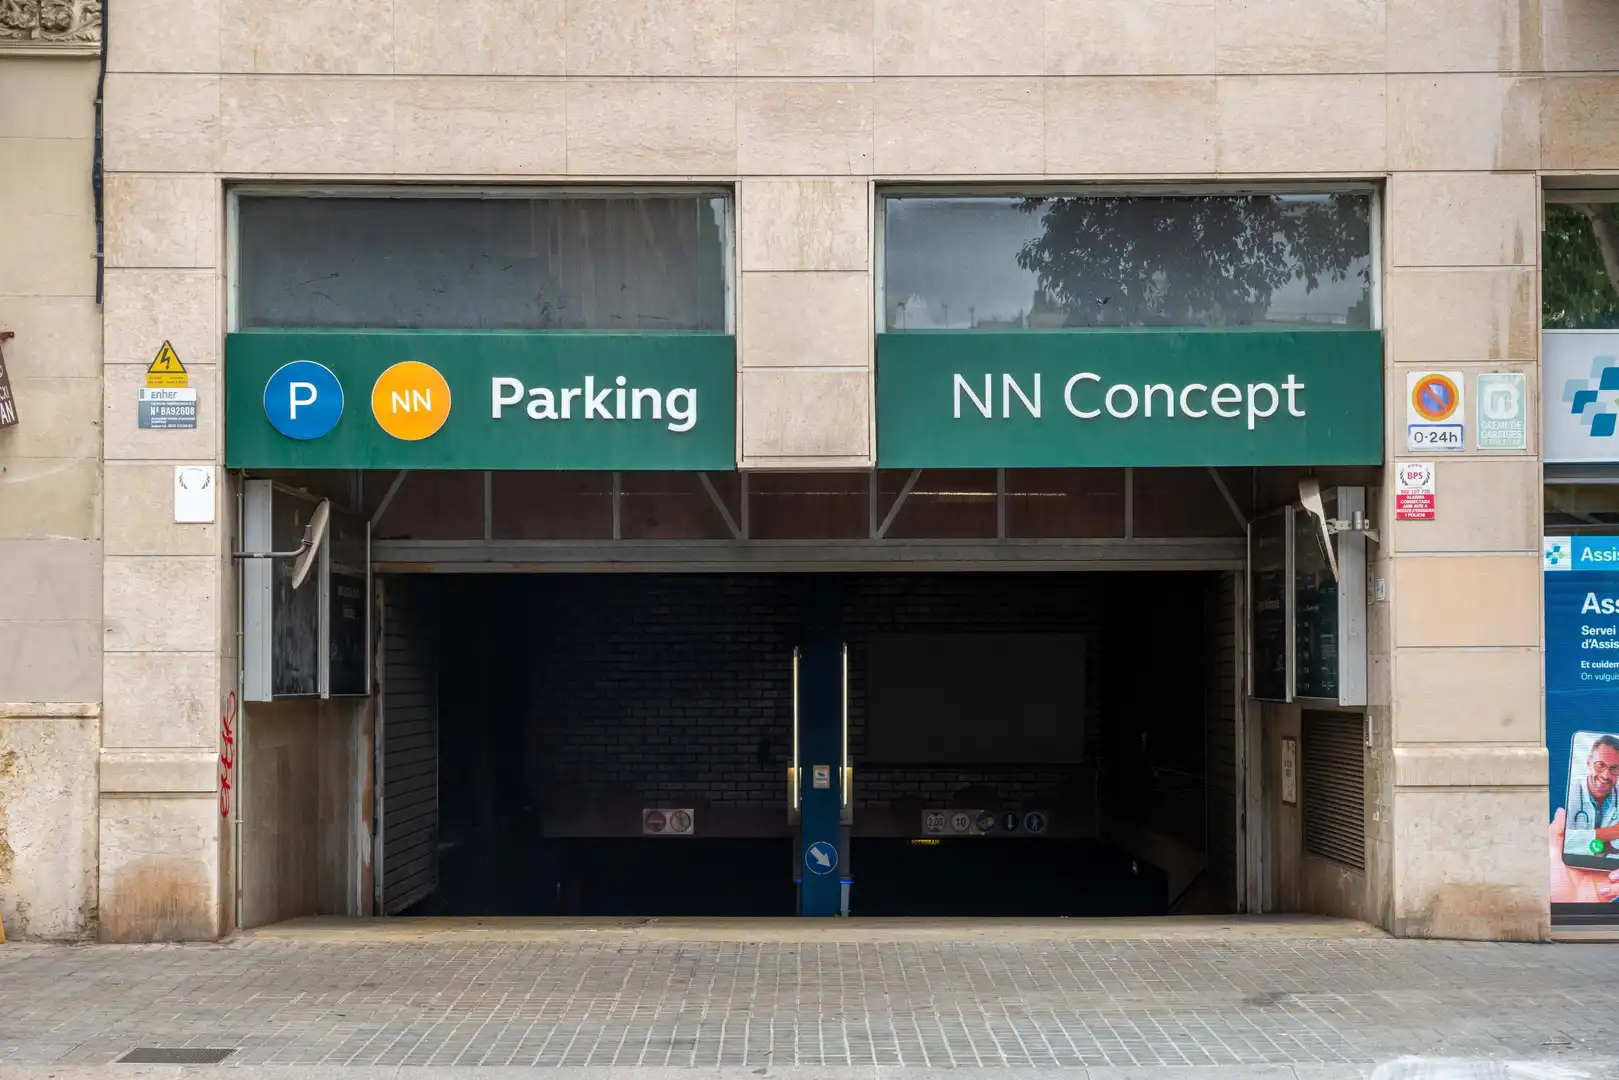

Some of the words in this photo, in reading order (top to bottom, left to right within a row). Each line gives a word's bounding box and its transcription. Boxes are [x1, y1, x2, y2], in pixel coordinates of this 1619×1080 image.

[289, 381, 318, 420] P
[391, 388, 432, 414] NN
[491, 376, 698, 432] Parking
[953, 373, 1042, 419] NN
[1063, 372, 1306, 430] Concept
[1407, 472, 1423, 480] BPS
[1580, 546, 1619, 562] Assi
[1581, 592, 1619, 615] As
[1581, 625, 1616, 636] Servei
[1581, 660, 1590, 668] Et
[1581, 672, 1592, 680] On
[956, 816, 966, 827] 10
